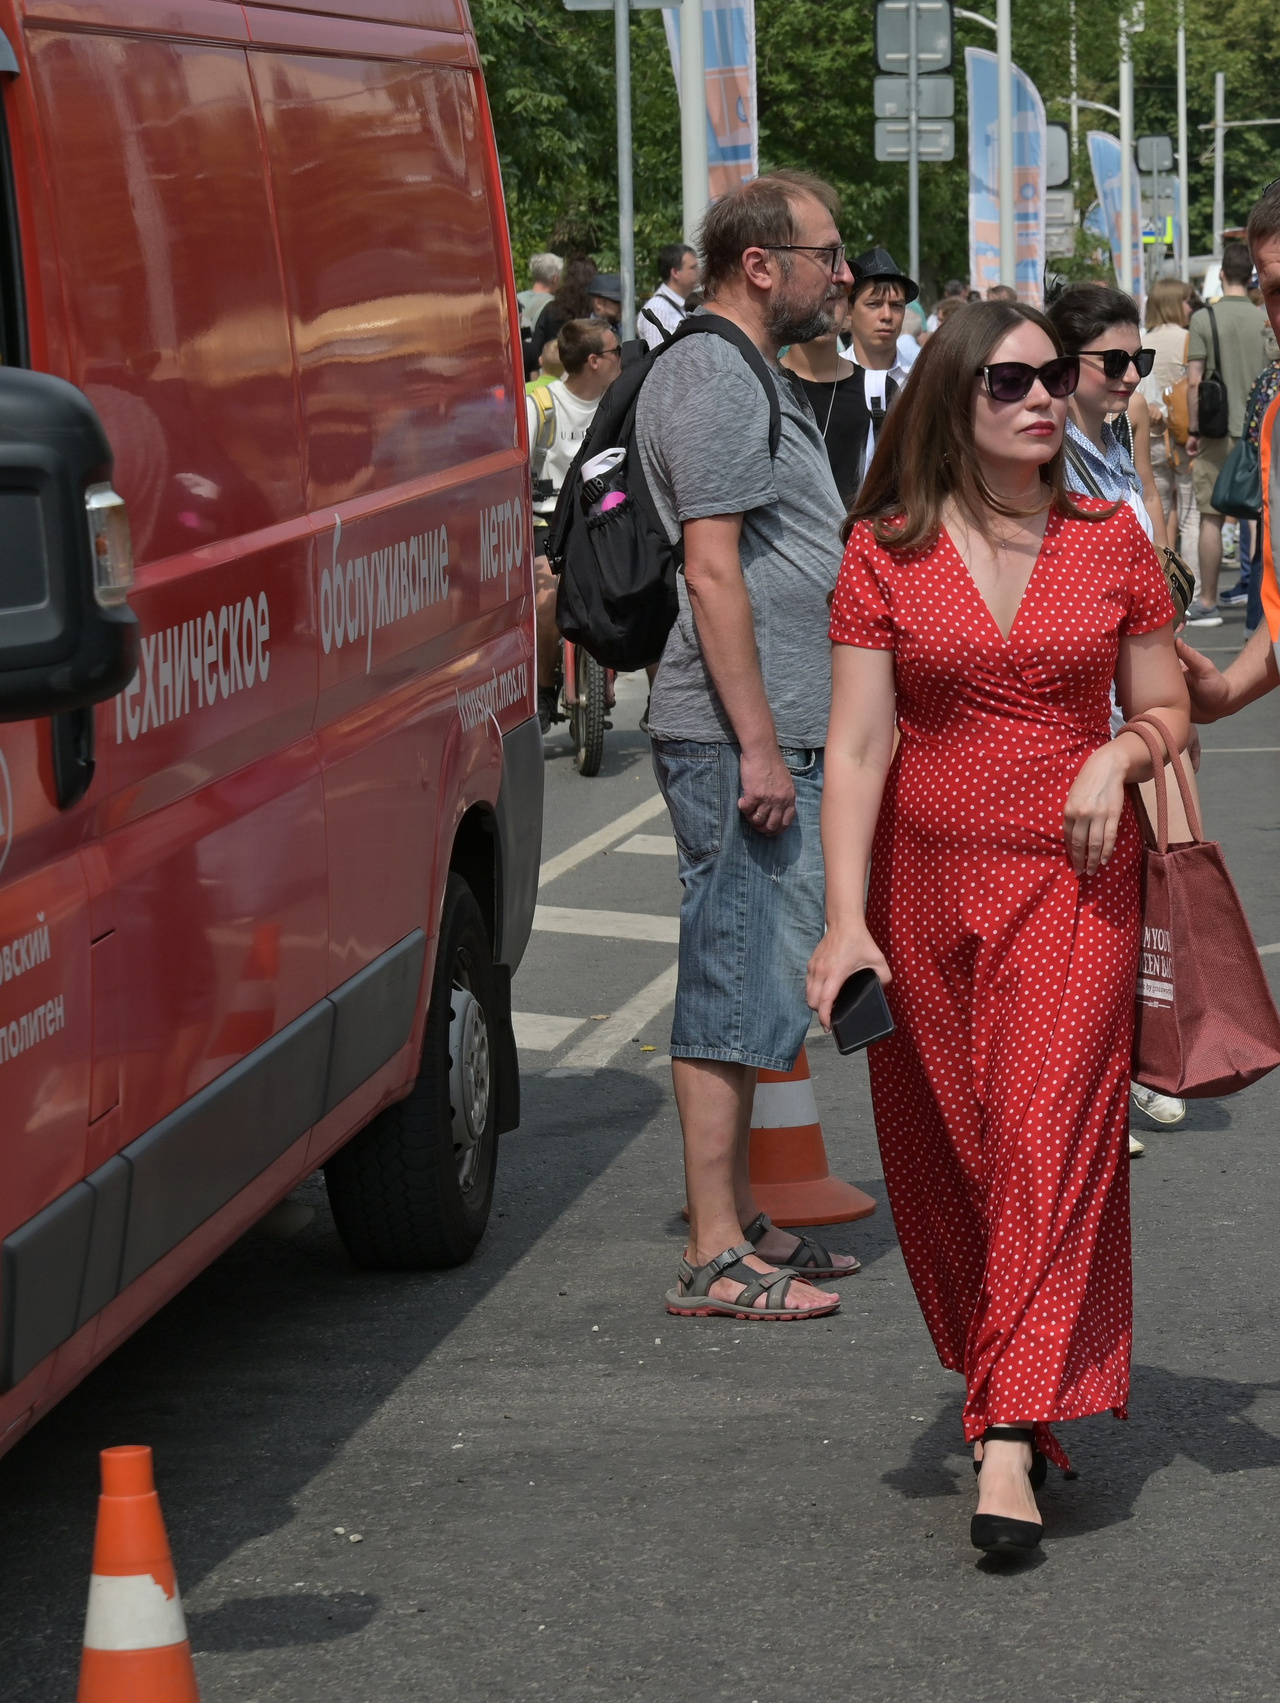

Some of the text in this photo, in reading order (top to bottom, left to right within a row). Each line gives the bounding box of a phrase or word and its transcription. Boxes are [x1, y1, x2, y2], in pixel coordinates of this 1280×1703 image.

[320, 512, 449, 675] обслуживание
[480, 496, 524, 602] метро
[455, 662, 528, 738] transport.mos.ru
[0, 910, 51, 987] вский
